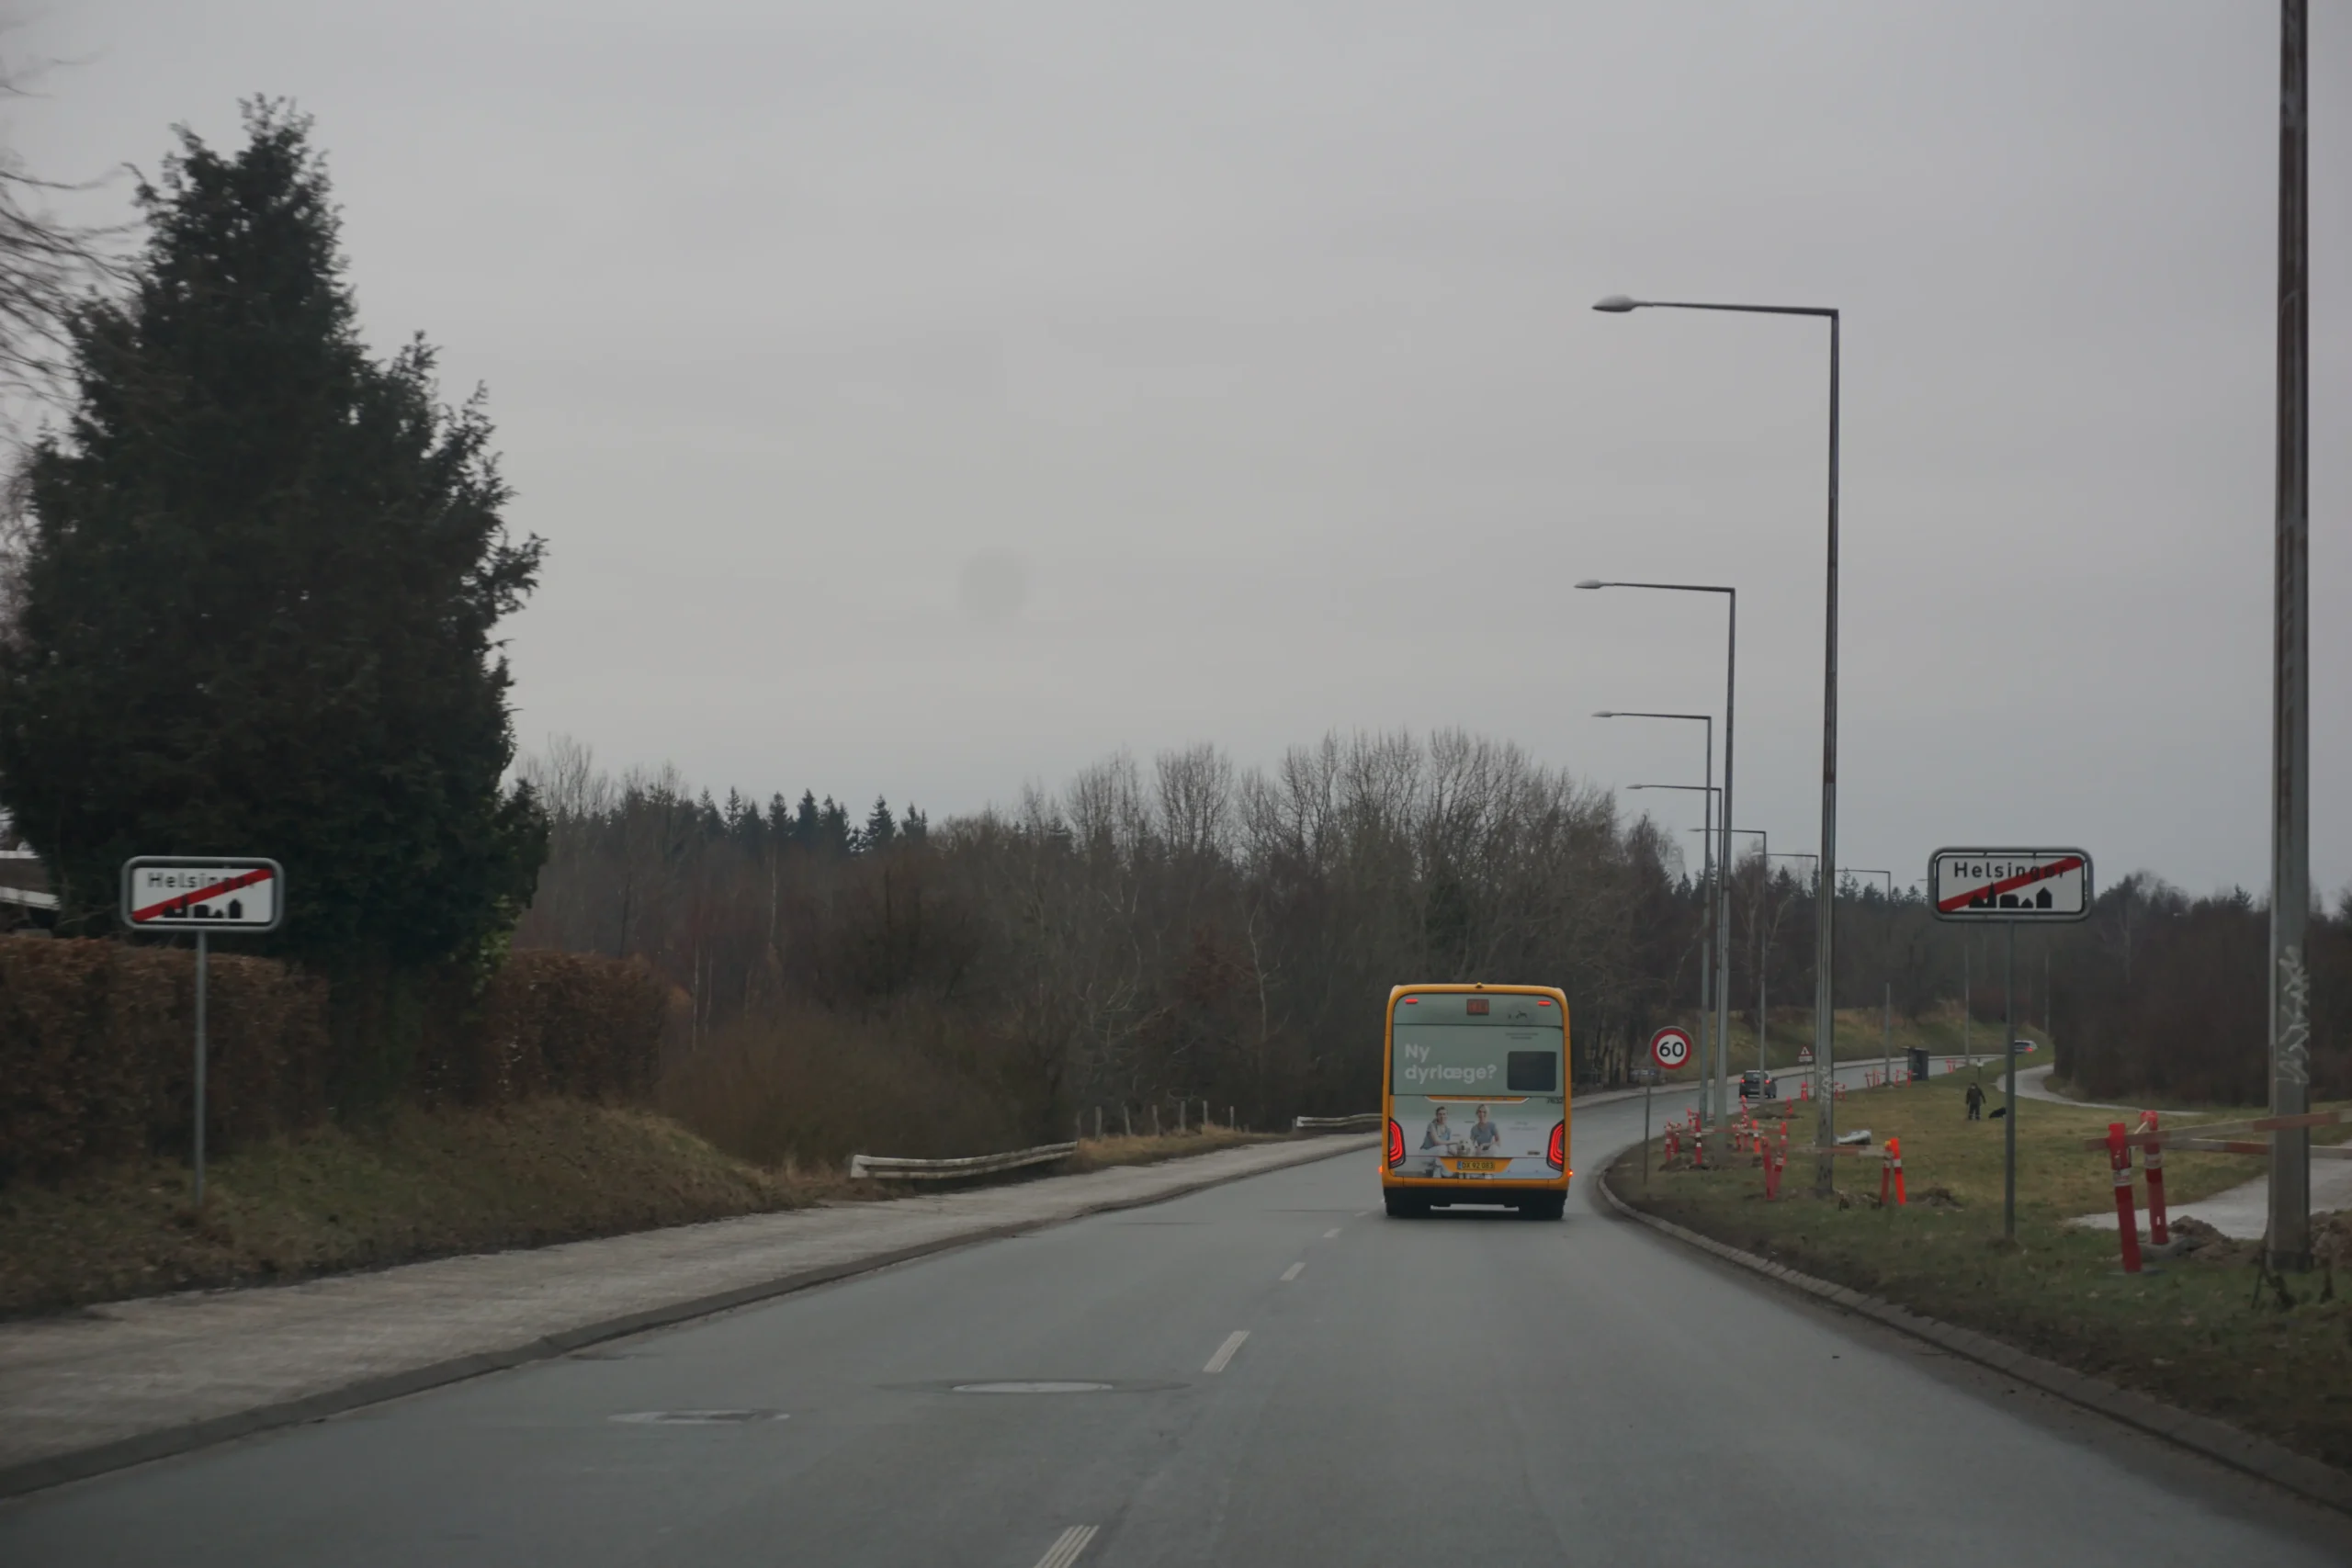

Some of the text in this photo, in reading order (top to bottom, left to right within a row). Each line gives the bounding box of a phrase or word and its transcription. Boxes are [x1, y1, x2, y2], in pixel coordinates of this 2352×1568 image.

[1405, 1043, 1430, 1063] Ny
[1659, 1041, 1684, 1057] 60
[1404, 1064, 1498, 1084] dyrlæge?
